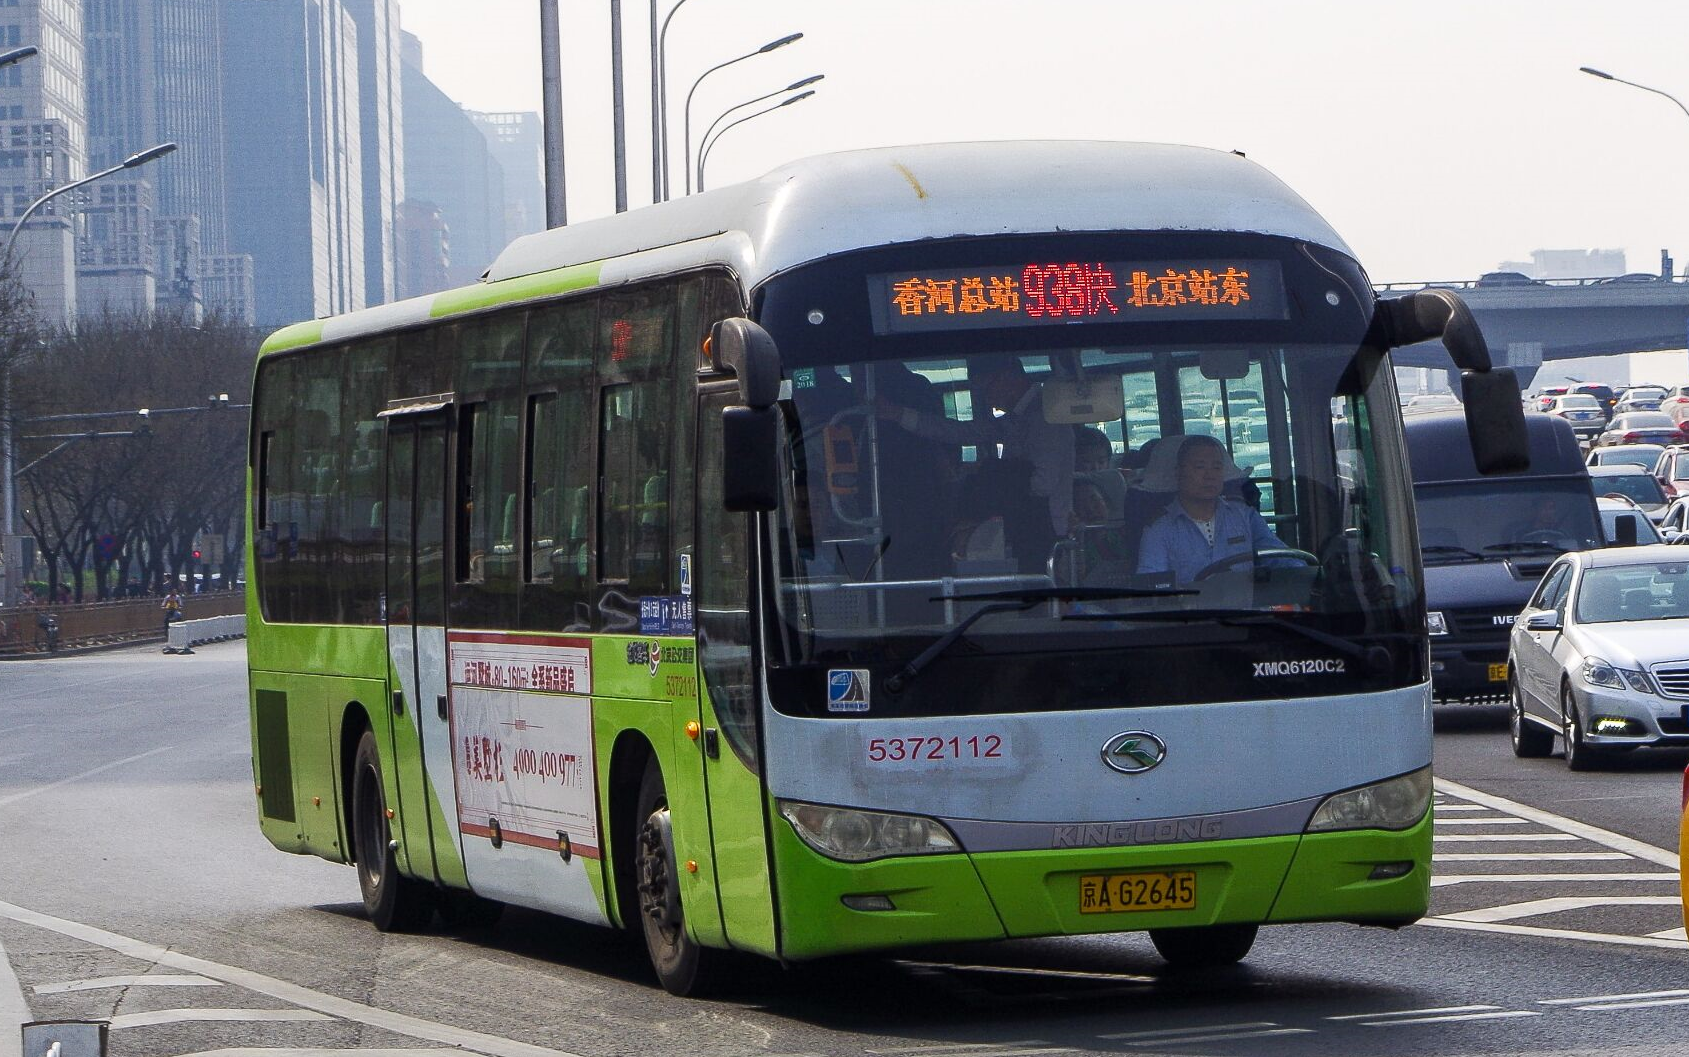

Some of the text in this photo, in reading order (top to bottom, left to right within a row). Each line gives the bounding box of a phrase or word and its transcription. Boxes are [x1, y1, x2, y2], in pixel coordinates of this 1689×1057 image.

[892, 262, 1250, 318] 香河总站 938快 北京站东
[1253, 659, 1346, 678] XMQ6120C2
[666, 675, 697, 697] 5372112
[868, 735, 1002, 762] 5372112
